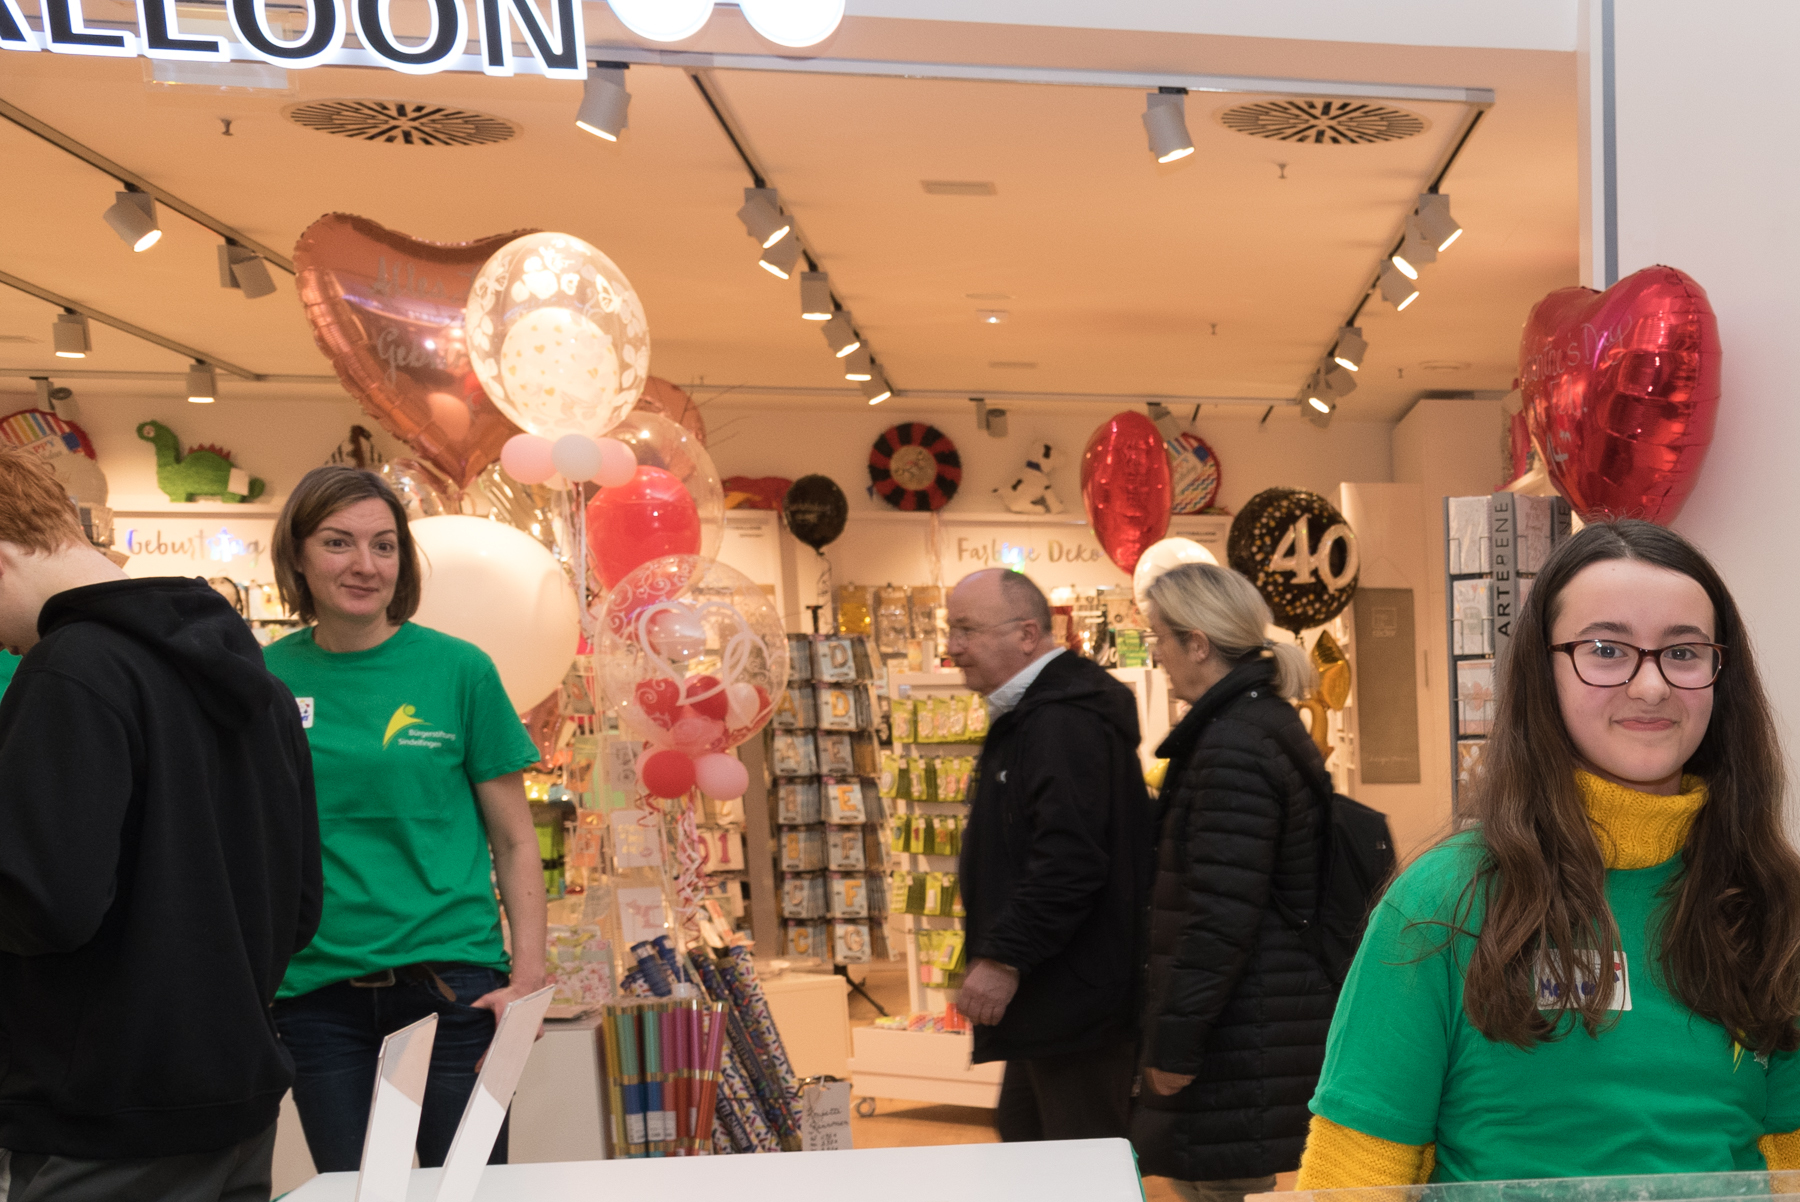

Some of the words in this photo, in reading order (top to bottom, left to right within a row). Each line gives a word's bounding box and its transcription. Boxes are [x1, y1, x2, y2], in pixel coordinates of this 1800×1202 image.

[0, 0, 586, 79] LLOON
[1048, 538, 1105, 563] Deko
[1269, 513, 1360, 594] 40
[830, 691, 850, 716] D
[836, 785, 857, 811] E
[843, 880, 862, 907] F
